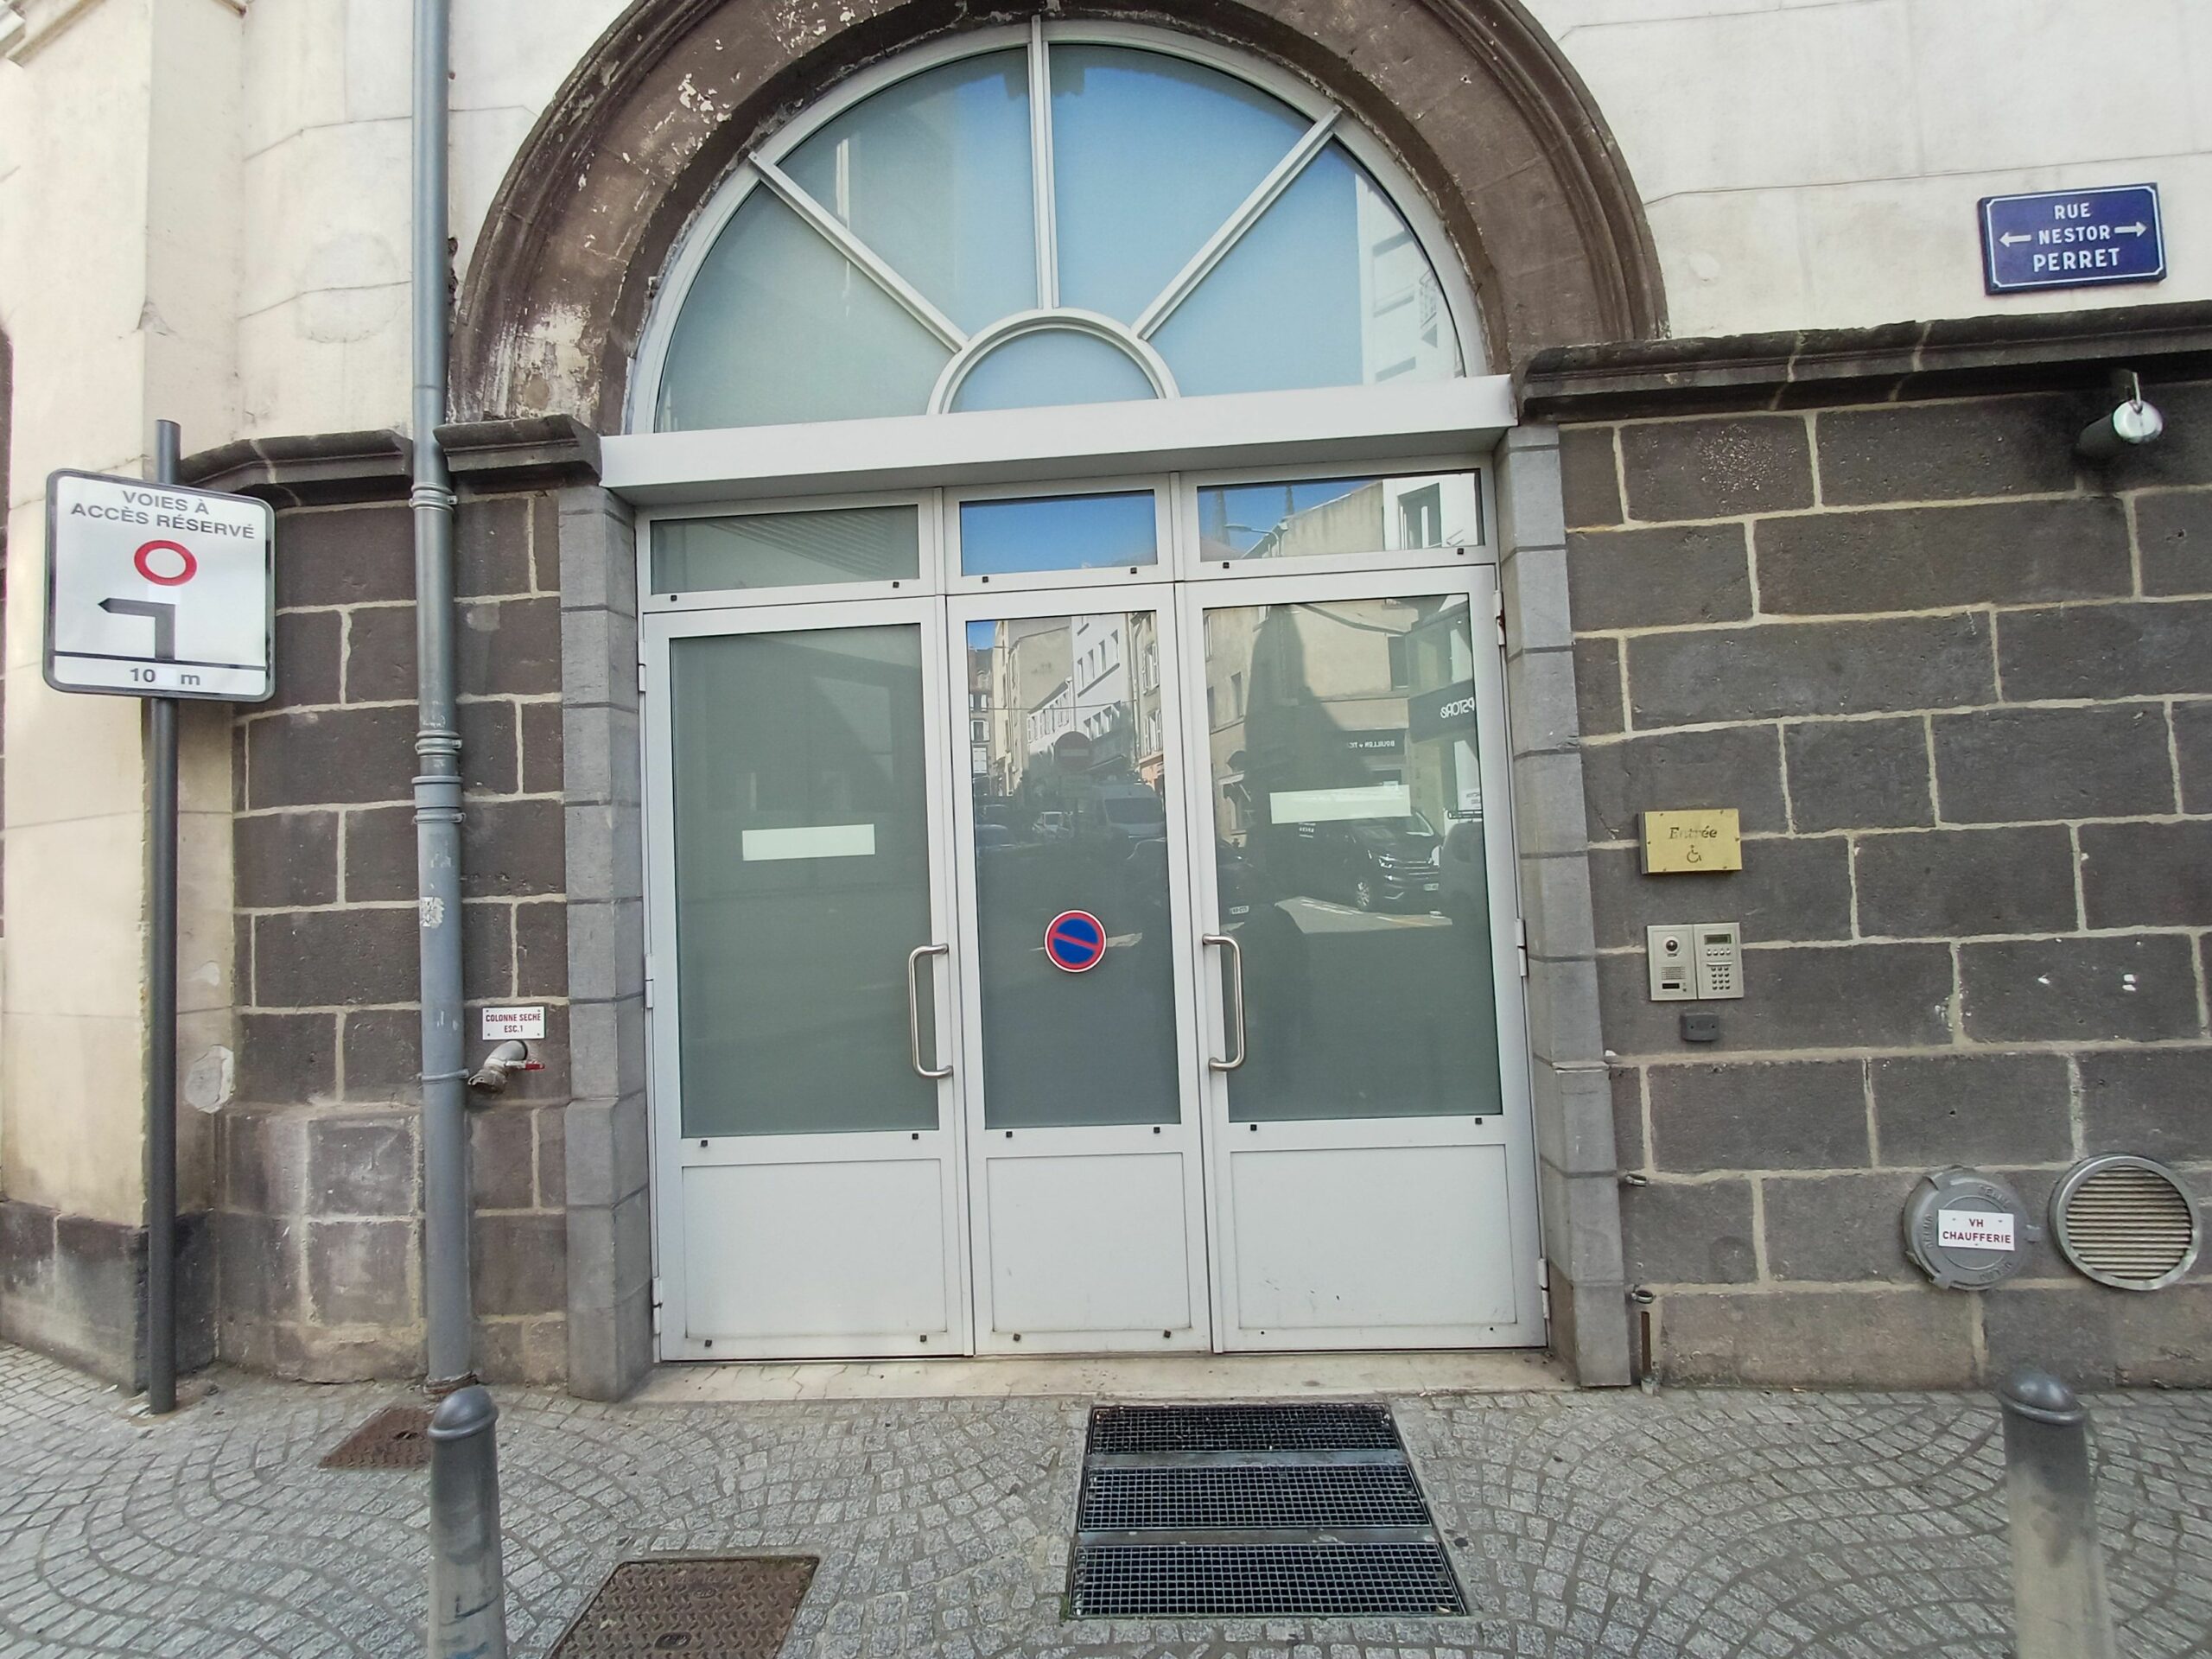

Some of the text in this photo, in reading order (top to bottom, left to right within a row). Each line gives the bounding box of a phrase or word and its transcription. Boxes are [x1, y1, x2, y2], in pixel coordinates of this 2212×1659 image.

[2054, 202, 2091, 219] RUE
[2038, 225, 2111, 245] NESTOR
[2033, 248, 2120, 272] PERRET
[122, 490, 209, 515] VOIES À
[70, 503, 255, 539] ACCÈS RÉSERVÉ
[130, 668, 200, 685] 10 m
[1669, 825, 1718, 840] Entrée
[486, 1013, 542, 1022] COLONNE SECHE
[1968, 1218, 1984, 1228] VH
[1942, 1230, 2012, 1244] CHAUFFERIE
